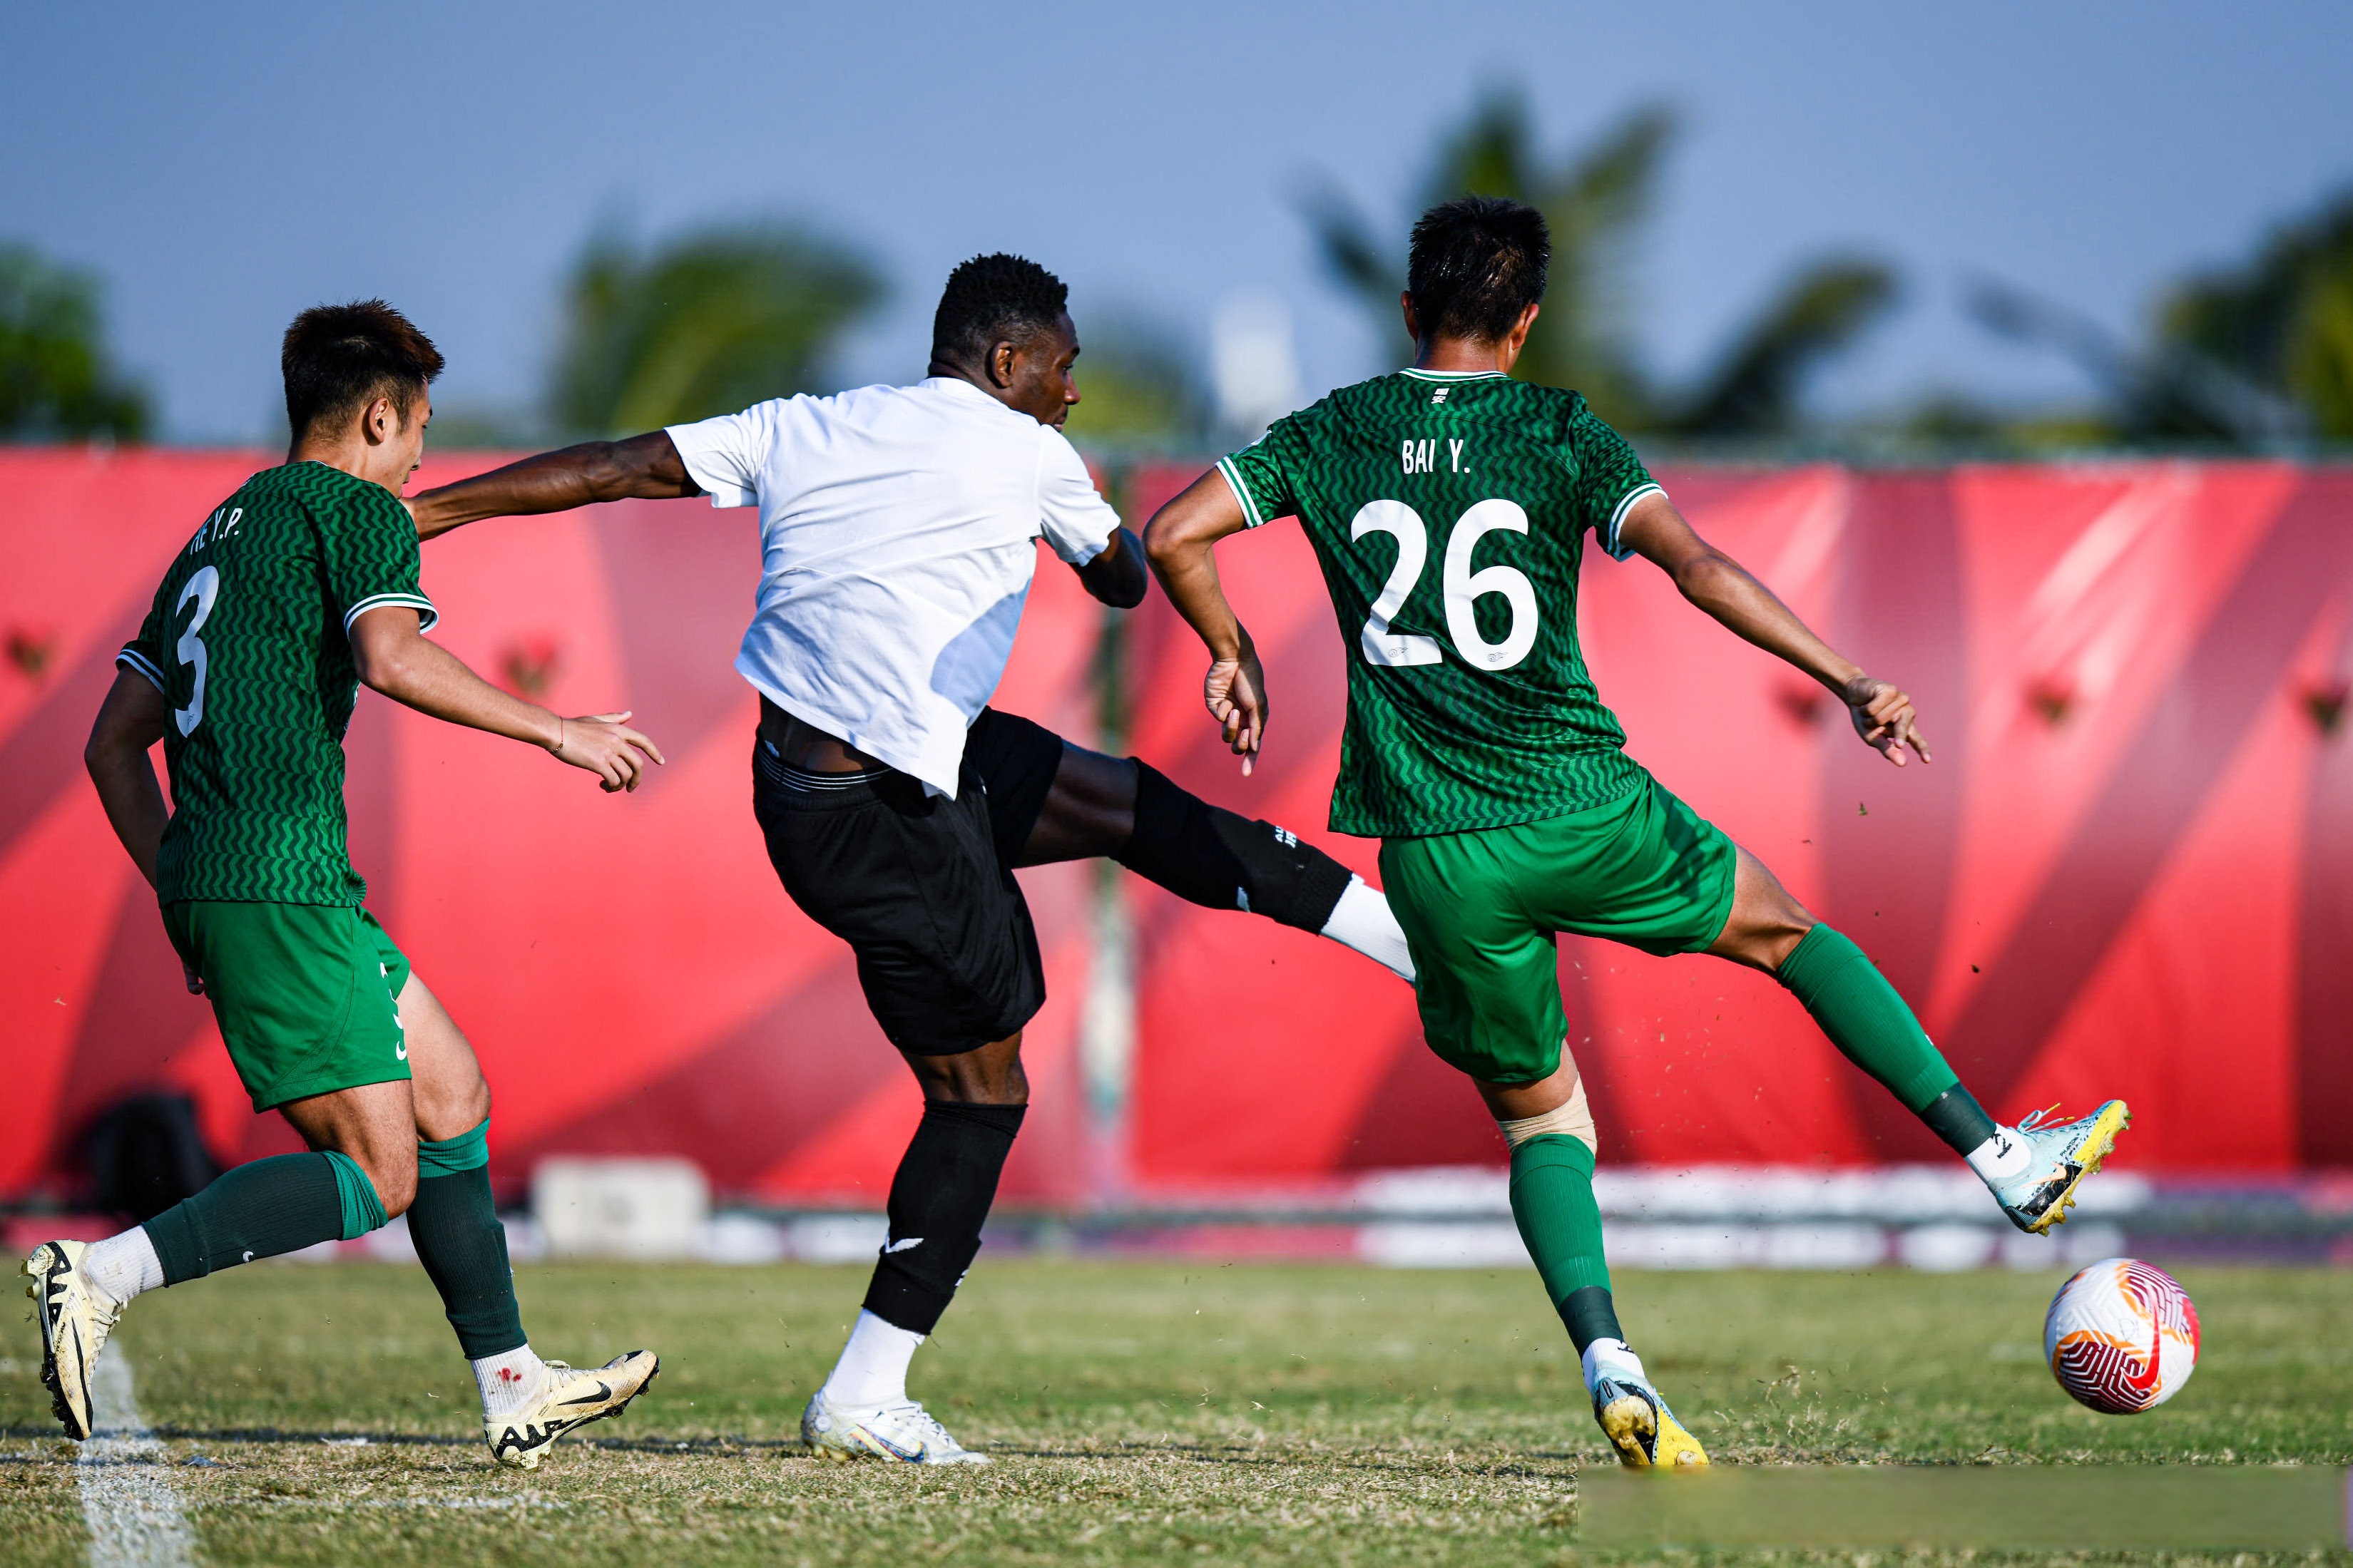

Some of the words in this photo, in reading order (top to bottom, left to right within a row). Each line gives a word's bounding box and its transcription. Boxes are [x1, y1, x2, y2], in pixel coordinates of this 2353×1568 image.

[1402, 439, 1436, 474] BAI
[1449, 439, 1471, 473] Y.
[211, 507, 243, 542] Y.P.
[1350, 498, 1538, 671] 26
[175, 565, 220, 739] 3
